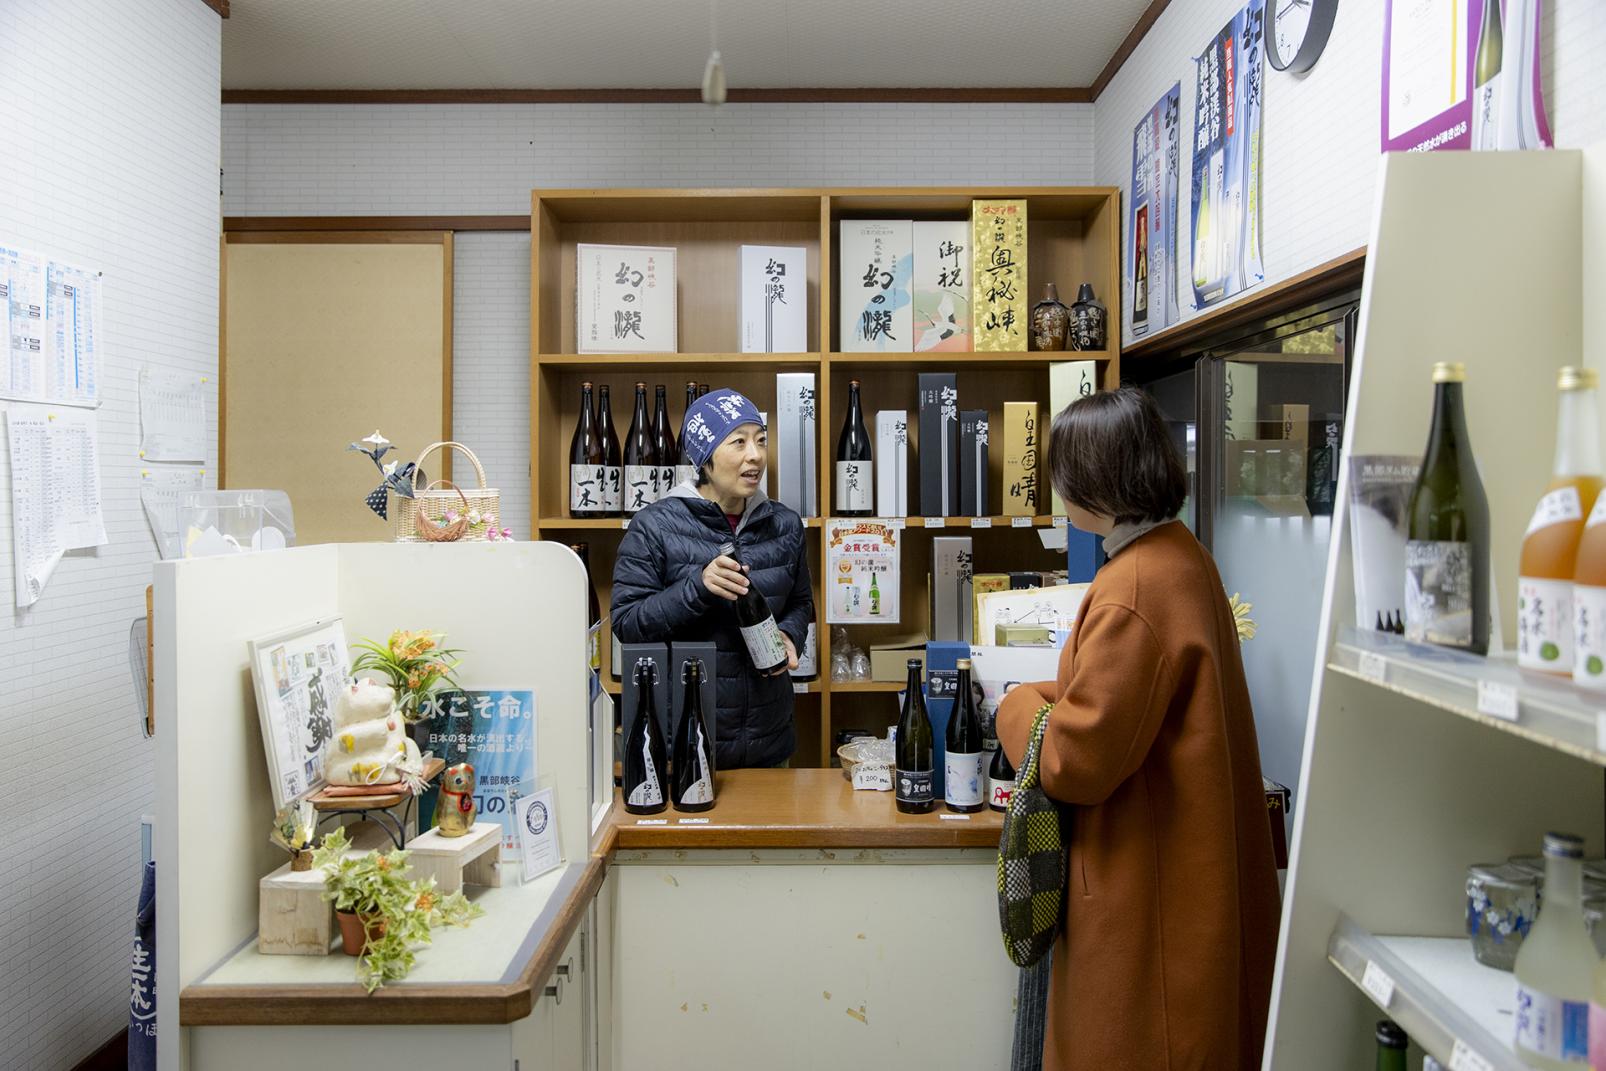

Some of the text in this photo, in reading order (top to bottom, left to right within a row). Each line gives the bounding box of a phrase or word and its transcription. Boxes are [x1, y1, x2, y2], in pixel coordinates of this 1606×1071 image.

[614, 262, 646, 341] 幻の瀧
[765, 258, 788, 305] 幻の瀧
[863, 263, 897, 341] 幻の瀧
[420, 695, 532, 720] 水こそ命。
[480, 775, 520, 786] 黒部峡谷
